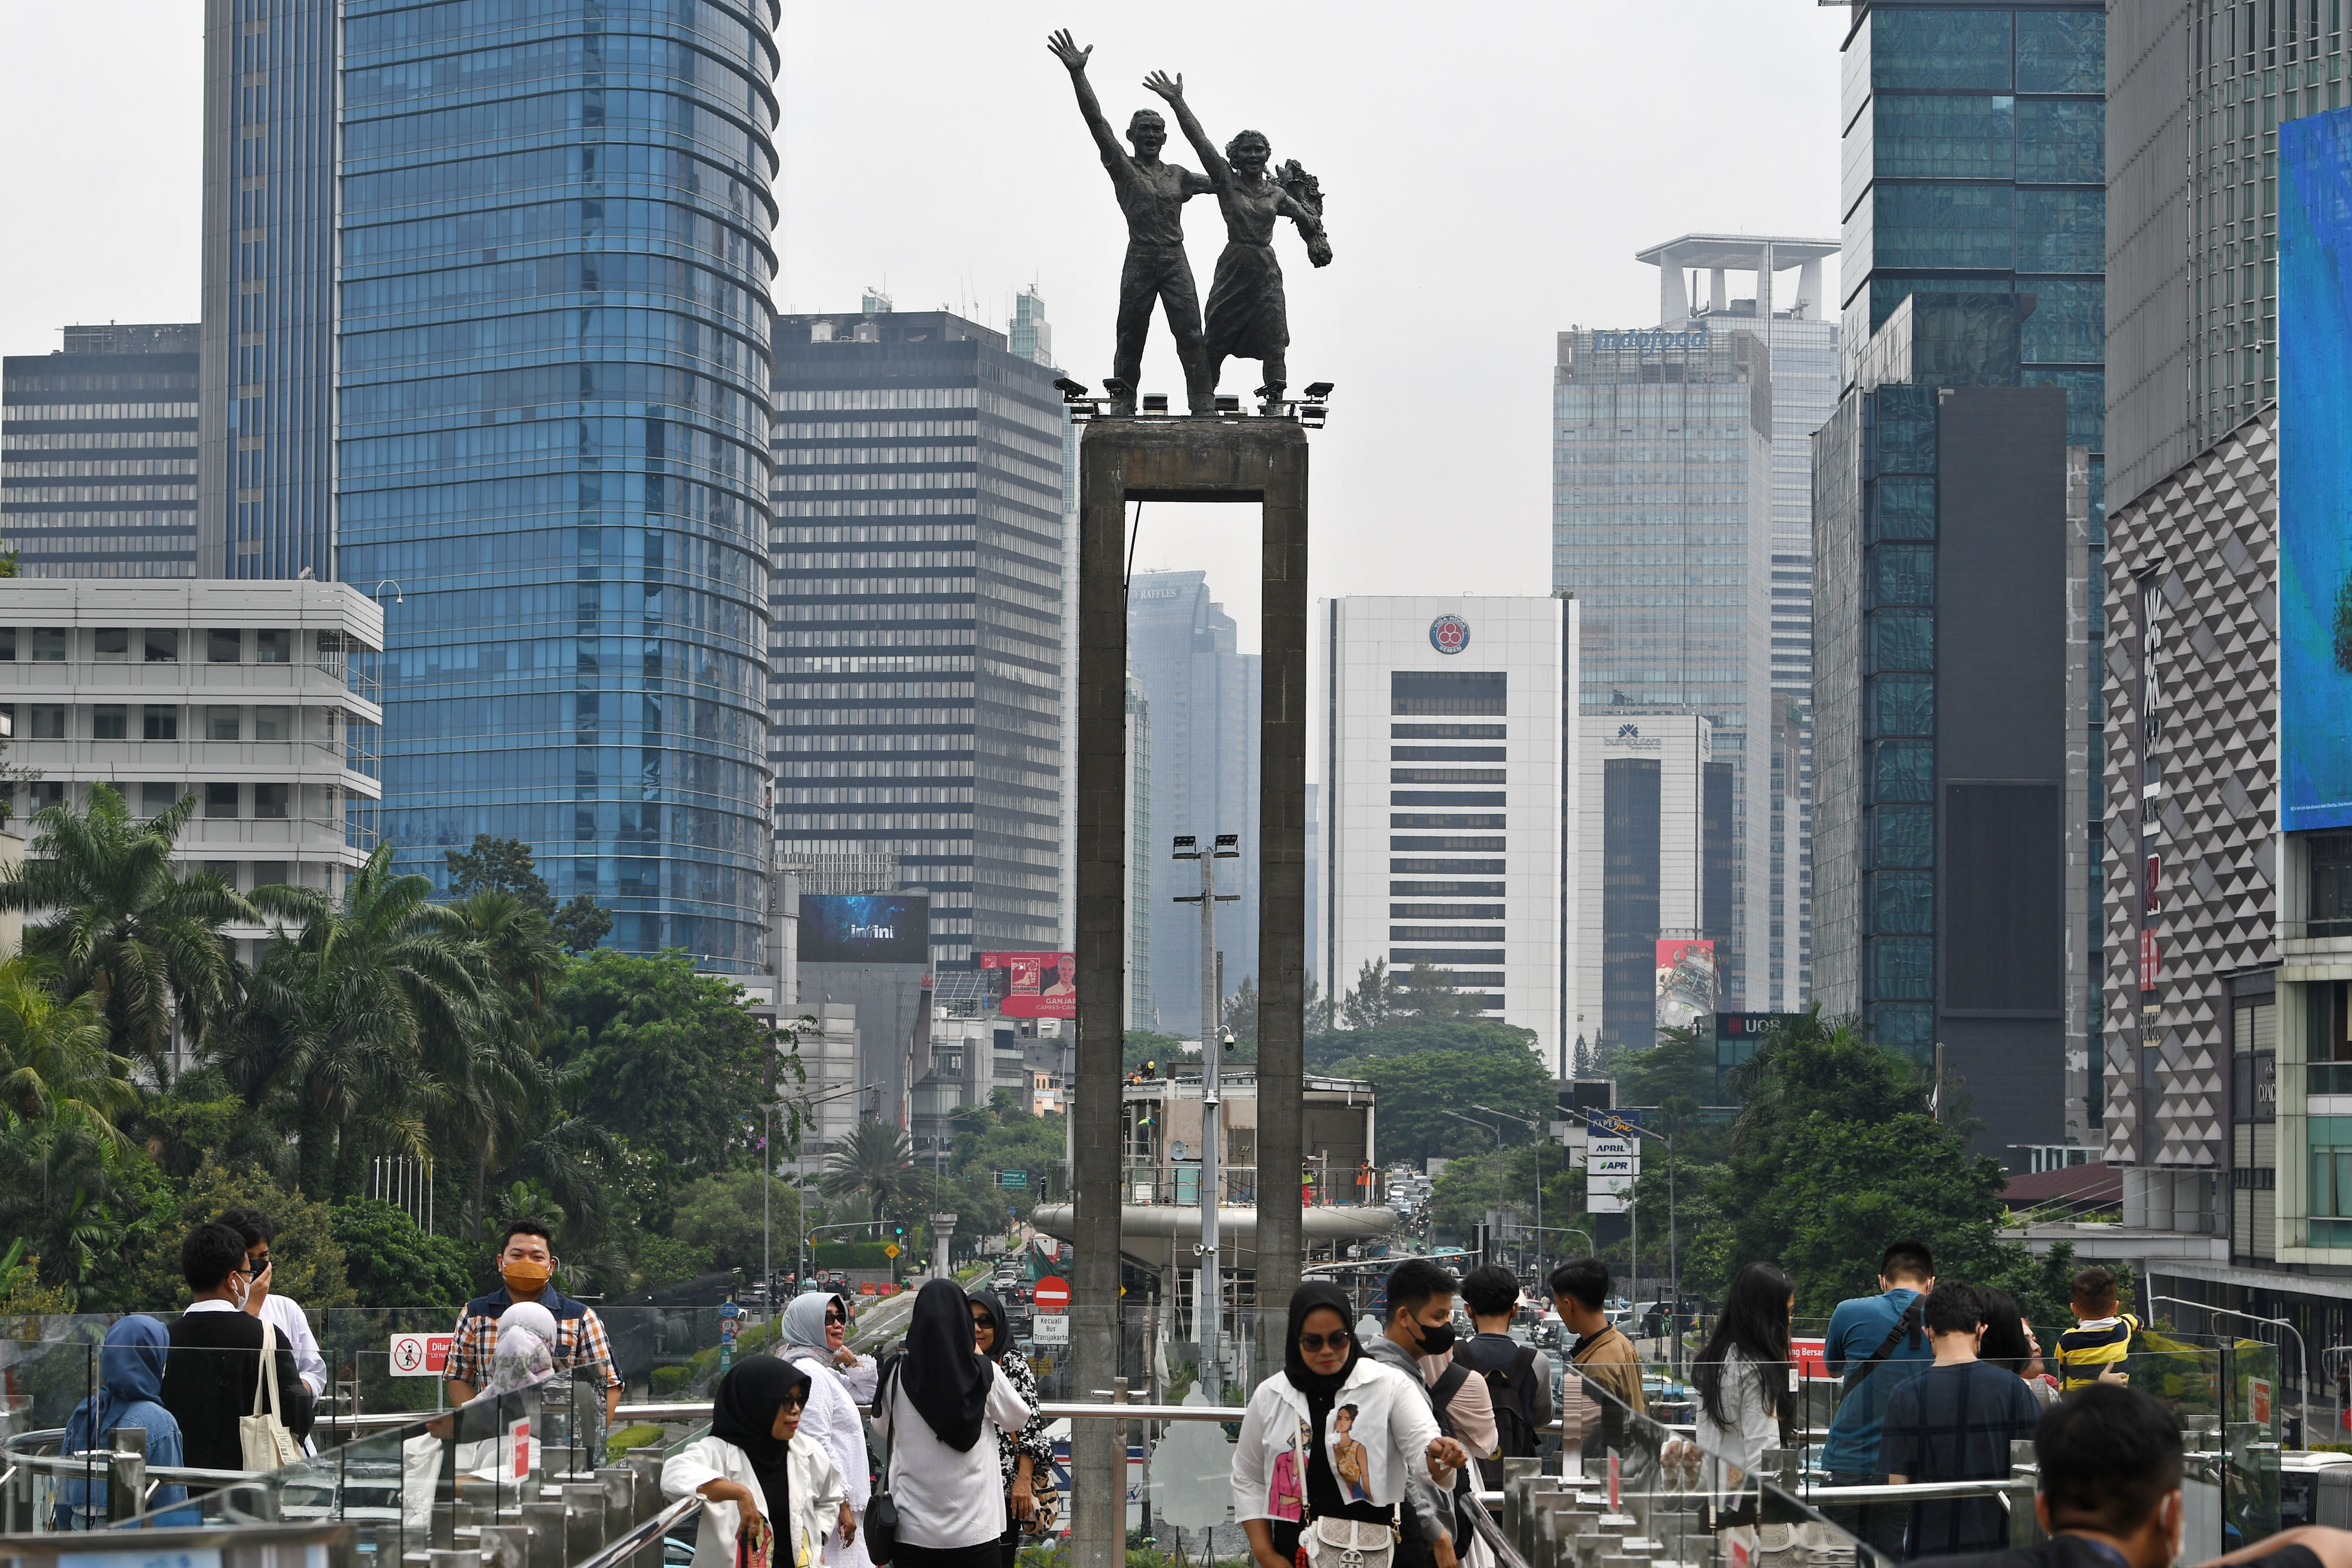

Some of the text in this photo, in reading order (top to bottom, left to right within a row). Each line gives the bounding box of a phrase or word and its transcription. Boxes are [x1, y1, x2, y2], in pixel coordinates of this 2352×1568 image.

[1594, 327, 1707, 357] Indofood
[1141, 589, 1176, 599] RAFFLES
[1434, 616, 1466, 629] TIGA RODA
[1011, 962, 1026, 971] PSI
[1034, 1333, 1068, 1342] Transjakarta
